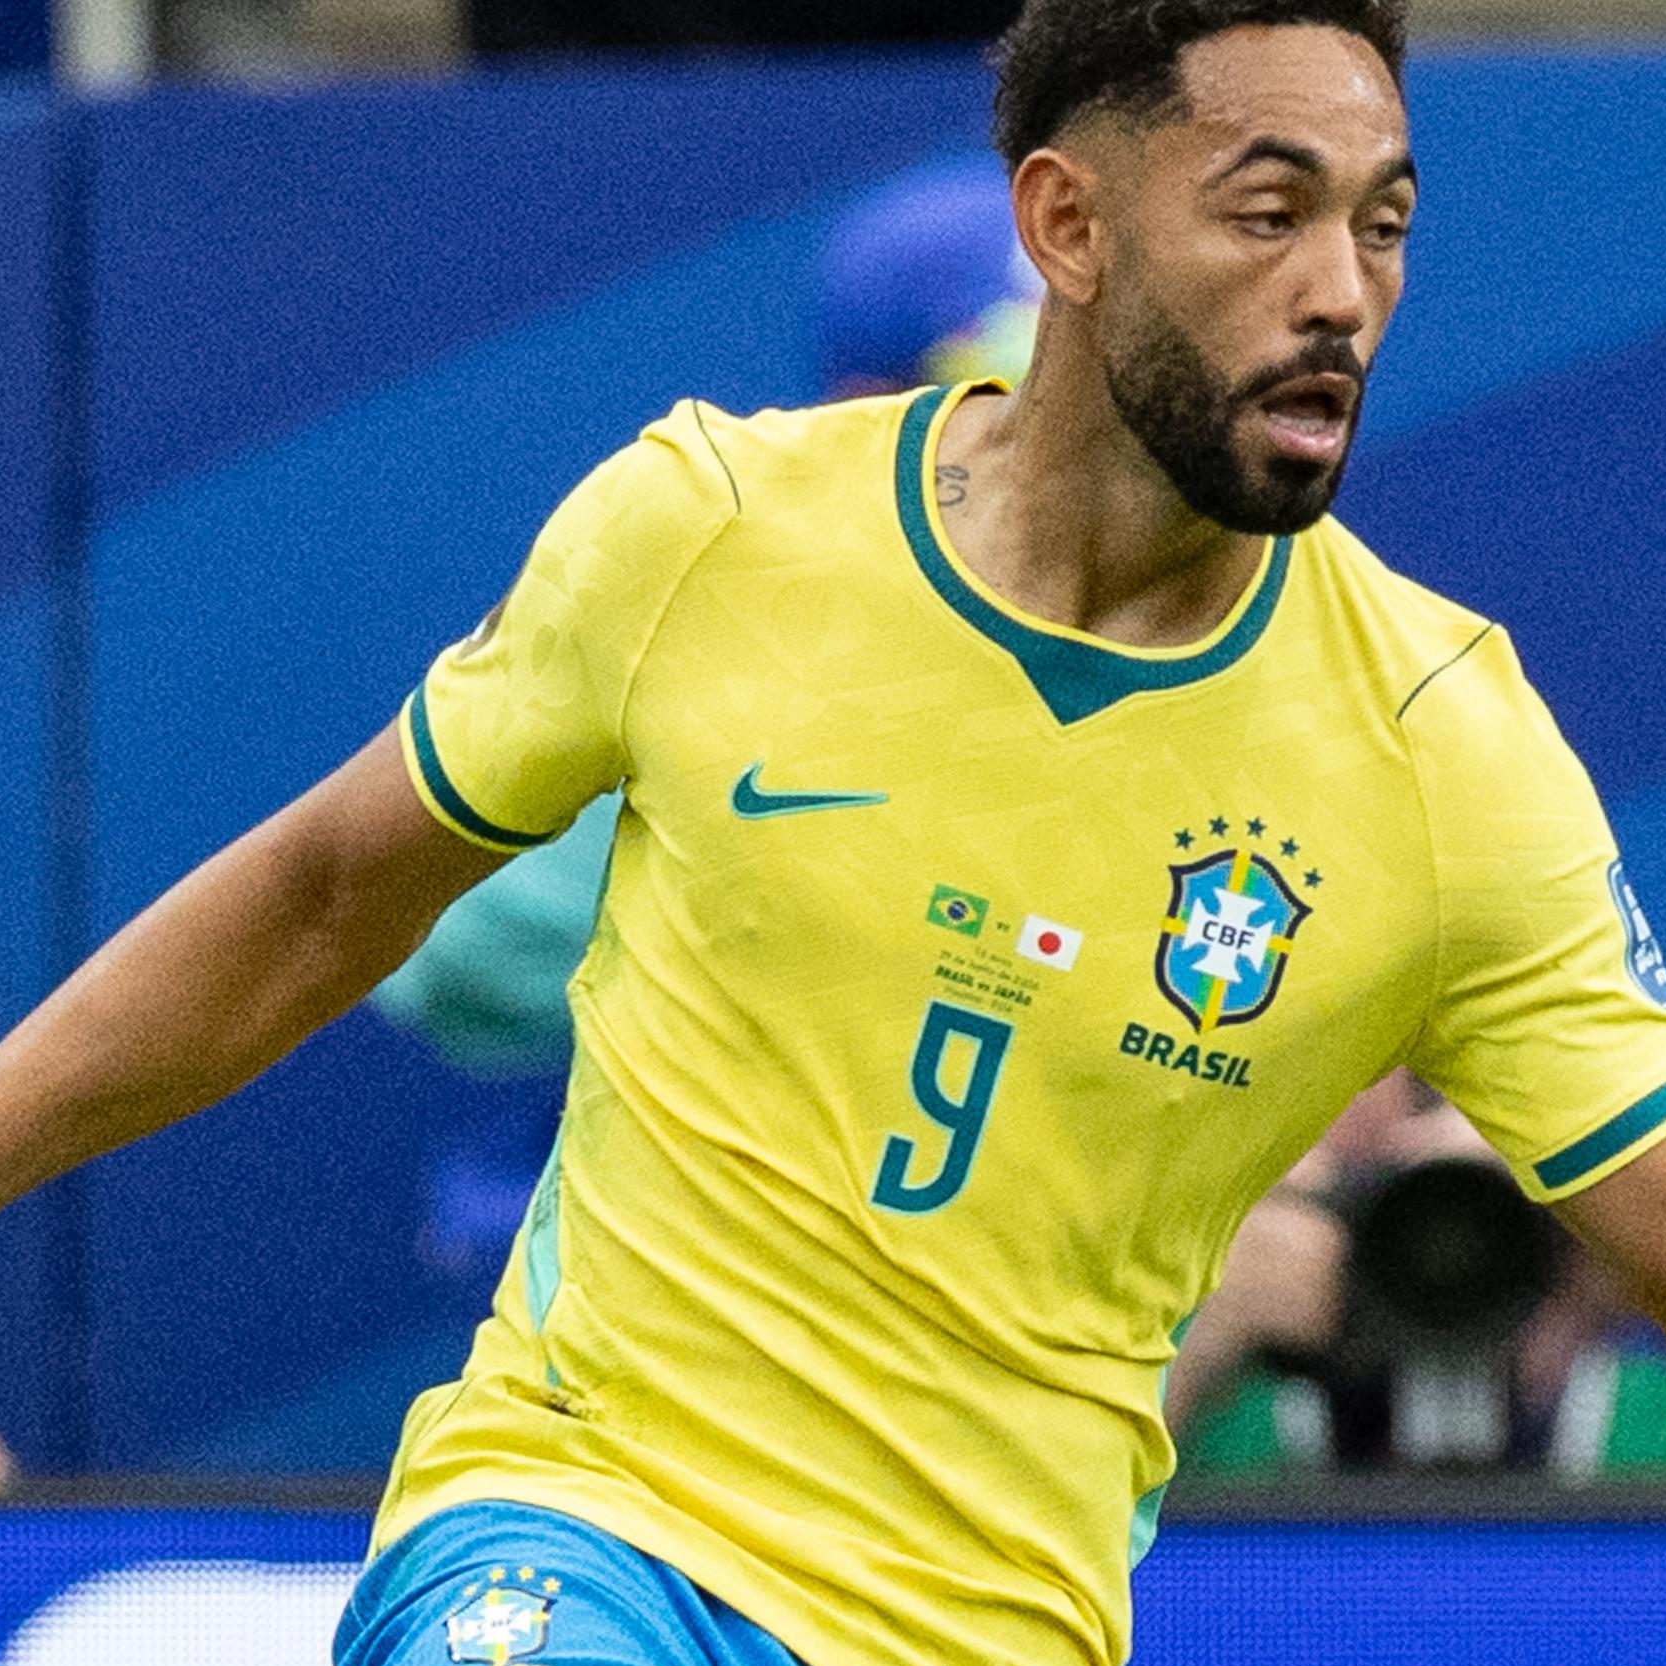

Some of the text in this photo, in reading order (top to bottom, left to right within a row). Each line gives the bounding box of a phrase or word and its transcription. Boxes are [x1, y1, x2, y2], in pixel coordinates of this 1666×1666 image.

[1201, 919, 1255, 951] CBF
[935, 965, 975, 987] BRASIL
[1119, 1022, 1253, 1088] BRASIL
[869, 998, 1015, 1216] 9
